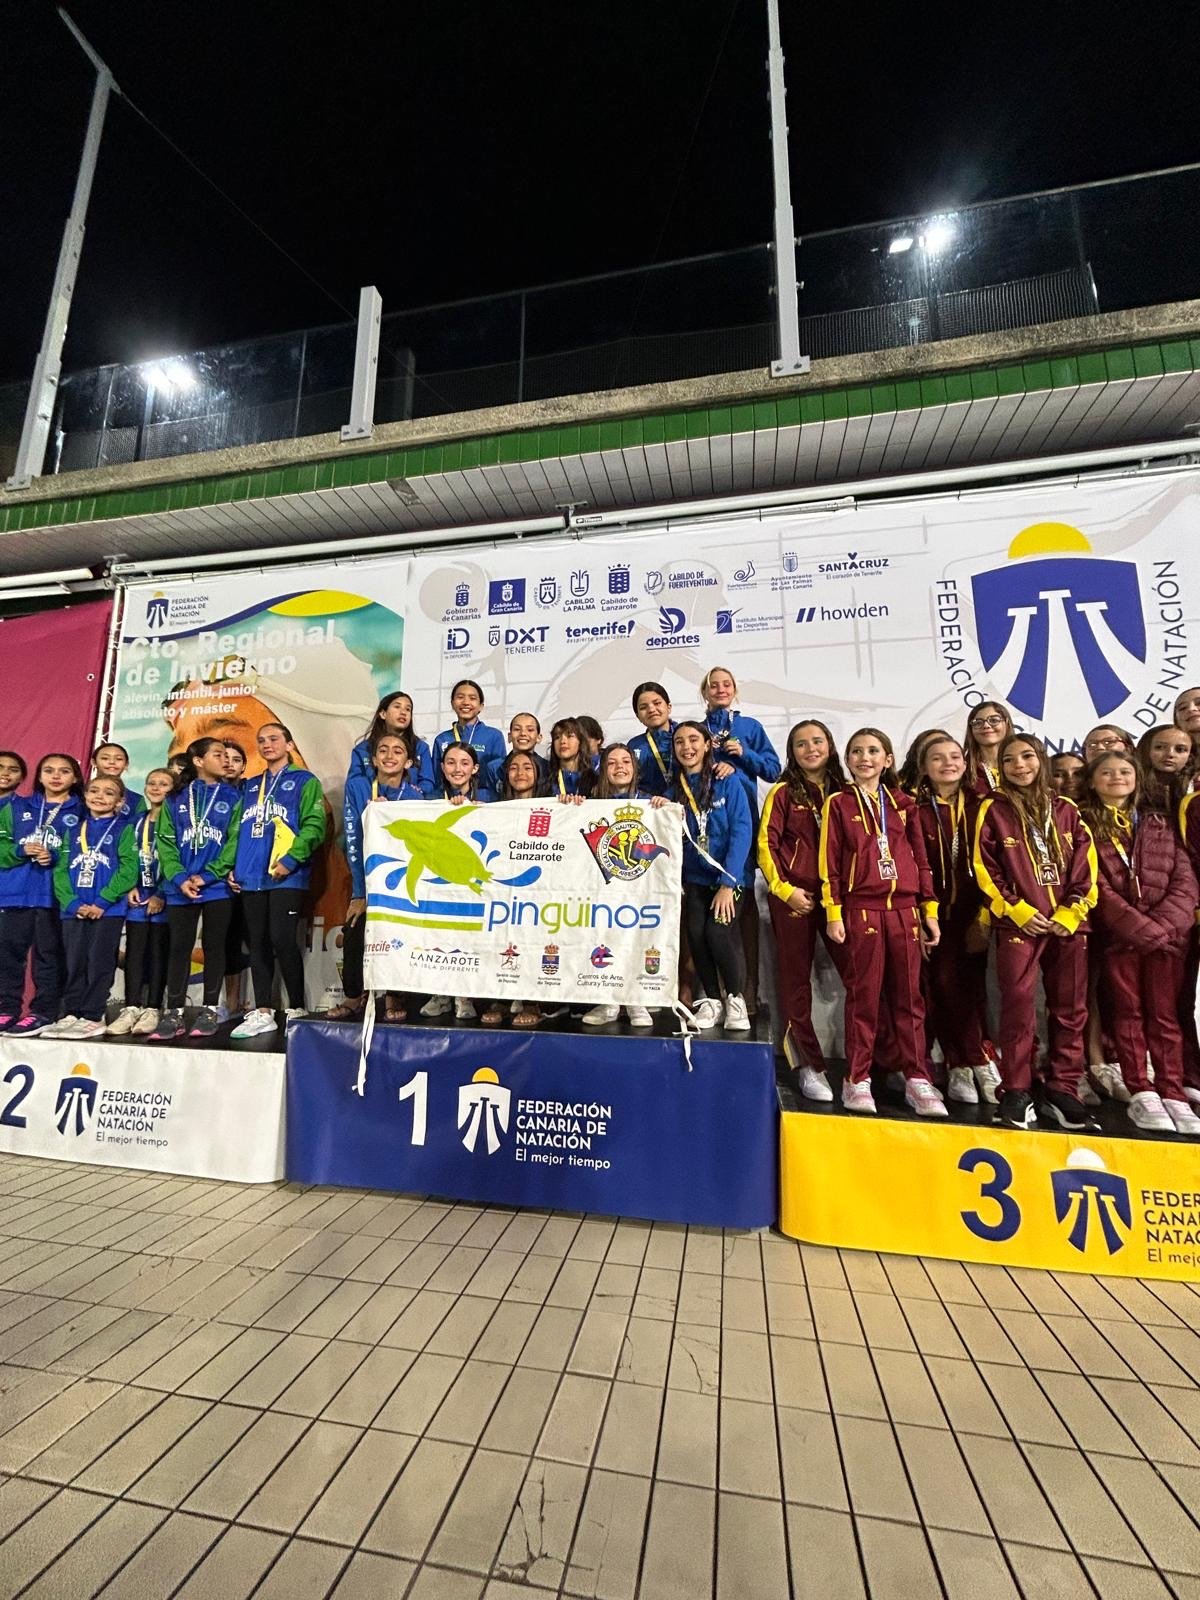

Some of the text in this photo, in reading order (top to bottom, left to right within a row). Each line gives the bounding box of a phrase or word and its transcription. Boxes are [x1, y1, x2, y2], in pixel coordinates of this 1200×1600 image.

[668, 572, 694, 581] CABILDO
[668, 578, 718, 589] FUERTEVENTURA
[565, 598, 595, 606] CABILDO
[601, 604, 638, 612] Lanzarote
[451, 613, 481, 621] Canarias
[821, 603, 889, 620] howden
[130, 619, 336, 661] Cto. Regional
[505, 626, 550, 645] DXT
[646, 634, 700, 647] deportes
[505, 645, 544, 654] TENERIFE
[936, 561, 1187, 732] FEDERACIÓ DE NATACIÓN
[126, 654, 297, 686] de Invierno
[218, 684, 257, 700] junior
[122, 701, 237, 720] absoluto y máster
[508, 840, 565, 852] Cabildo de
[509, 852, 562, 862] Lanzarote
[488, 897, 662, 934] pingüinos
[411, 952, 480, 966] LANZAROTE
[0, 1064, 35, 1129] 2
[101, 1090, 172, 1106] FEDERACIÓN
[100, 1104, 167, 1119] CANARIA DE
[399, 1071, 428, 1146] 1
[517, 1100, 612, 1119] FEDERACIÓN
[97, 1117, 154, 1132] NATACIÓN
[516, 1116, 607, 1136] CANARIA DE
[96, 1132, 168, 1147] El mejor tiempo
[516, 1130, 591, 1150] NATACIÓN
[515, 1148, 611, 1171] El mejor tiempo
[957, 1148, 1021, 1242] 3
[1144, 1210, 1200, 1226] CANA
[1148, 1248, 1162, 1262] El
